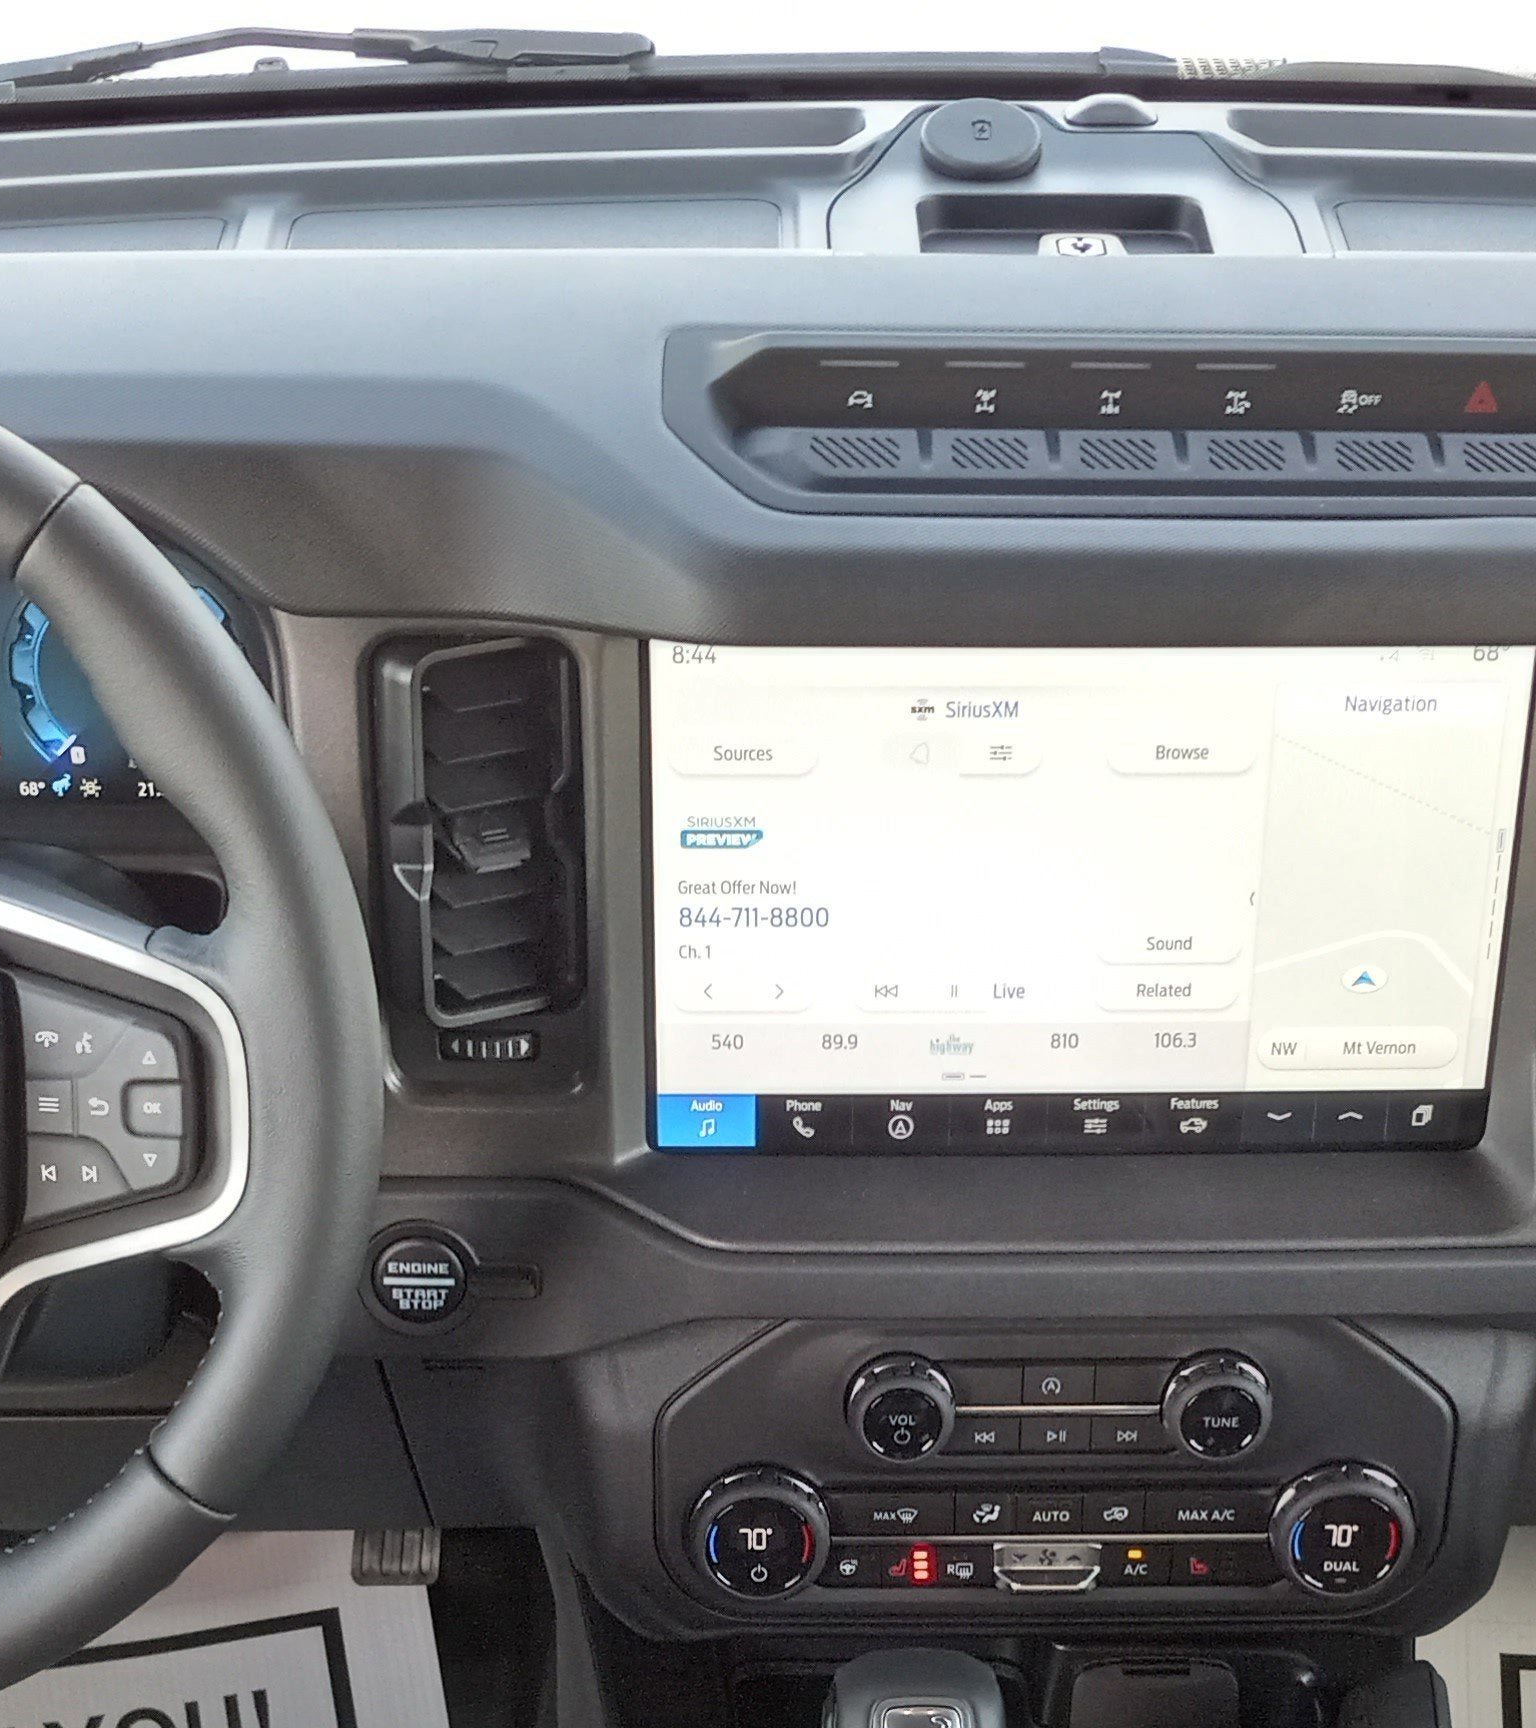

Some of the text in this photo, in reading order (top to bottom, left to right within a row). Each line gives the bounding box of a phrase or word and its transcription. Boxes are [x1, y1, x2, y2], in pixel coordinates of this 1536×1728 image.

[672, 645, 717, 664] 8:44
[945, 700, 1019, 719] SiriusXM
[1344, 696, 1438, 716] Navigation
[713, 745, 773, 762] Sources
[1155, 745, 1210, 761] Browse
[686, 815, 756, 828] SIRIUSXM
[685, 833, 758, 847] PREVIEW
[677, 880, 797, 896] Great Offer Now!
[678, 906, 830, 929] 844-711-8800
[1146, 936, 1193, 951] Sound
[678, 945, 702, 959] Ch.
[993, 983, 1025, 999] Live
[1136, 983, 1192, 998] Related
[711, 1034, 744, 1051] 540
[821, 1033, 859, 1051] 89.9
[1050, 1033, 1080, 1049] 810
[1154, 1032, 1197, 1049] 106.3
[1270, 1041, 1297, 1056] NW
[1343, 1041, 1416, 1056] Mt Vernon
[143, 1101, 162, 1114] OK
[690, 1099, 723, 1113] Audio
[786, 1099, 822, 1113] Phone
[890, 1099, 913, 1113] Nav
[983, 1099, 1014, 1115] Apps
[1072, 1097, 1120, 1113] Settings
[1169, 1097, 1219, 1111] Features
[388, 1262, 449, 1274] ENGINE
[392, 1288, 449, 1300] START
[399, 1299, 445, 1310] STOP
[888, 1414, 916, 1426] VOL
[1203, 1416, 1239, 1428] TUNE
[873, 1511, 897, 1522] MAX
[1032, 1510, 1071, 1522] AUTO
[1177, 1508, 1235, 1522] MAX A/C
[1123, 1563, 1148, 1577] A/C
[1323, 1561, 1360, 1573] DUAL
